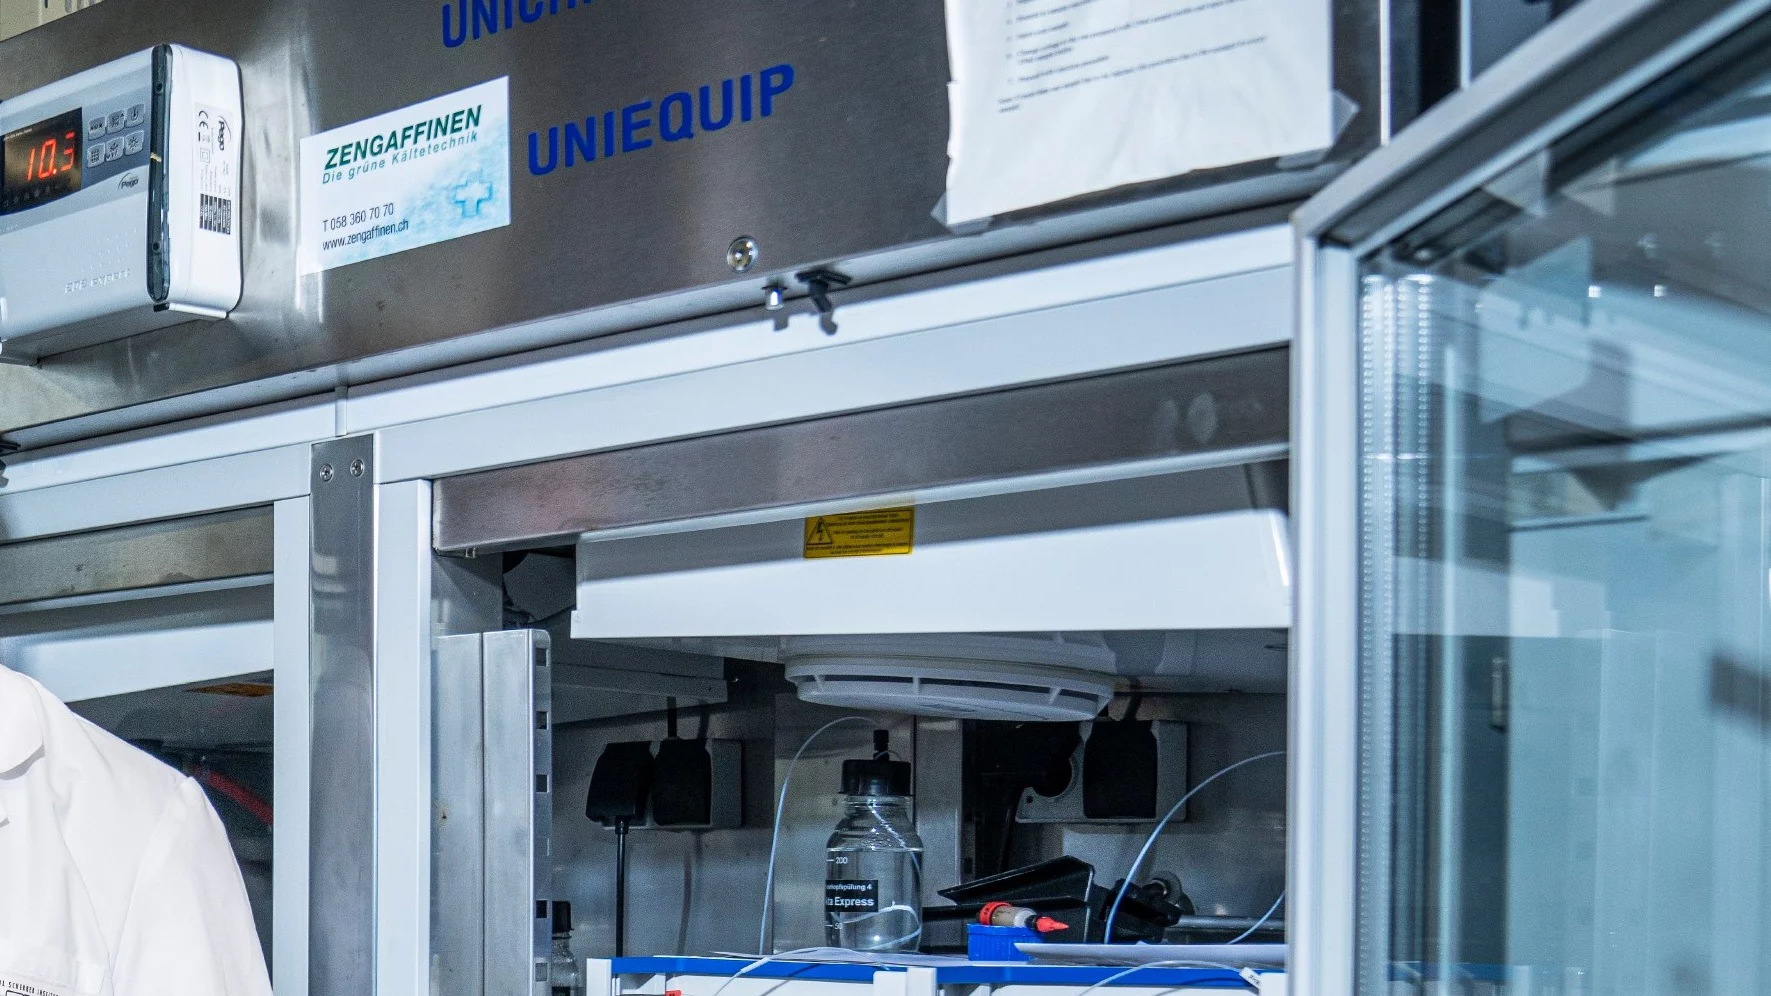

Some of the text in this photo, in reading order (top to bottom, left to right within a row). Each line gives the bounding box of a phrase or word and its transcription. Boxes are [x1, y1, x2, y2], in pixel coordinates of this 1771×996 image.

[442, 0, 592, 48] UNIC
[323, 104, 483, 171] ZENGAFFINEN
[528, 63, 795, 176] UNIEQUIP
[322, 130, 478, 185] Die grüne Kältetechnik
[322, 202, 394, 233] T 058 360 70 70
[322, 218, 409, 251] www.zengaffinen.ch
[834, 896, 875, 908] Express
